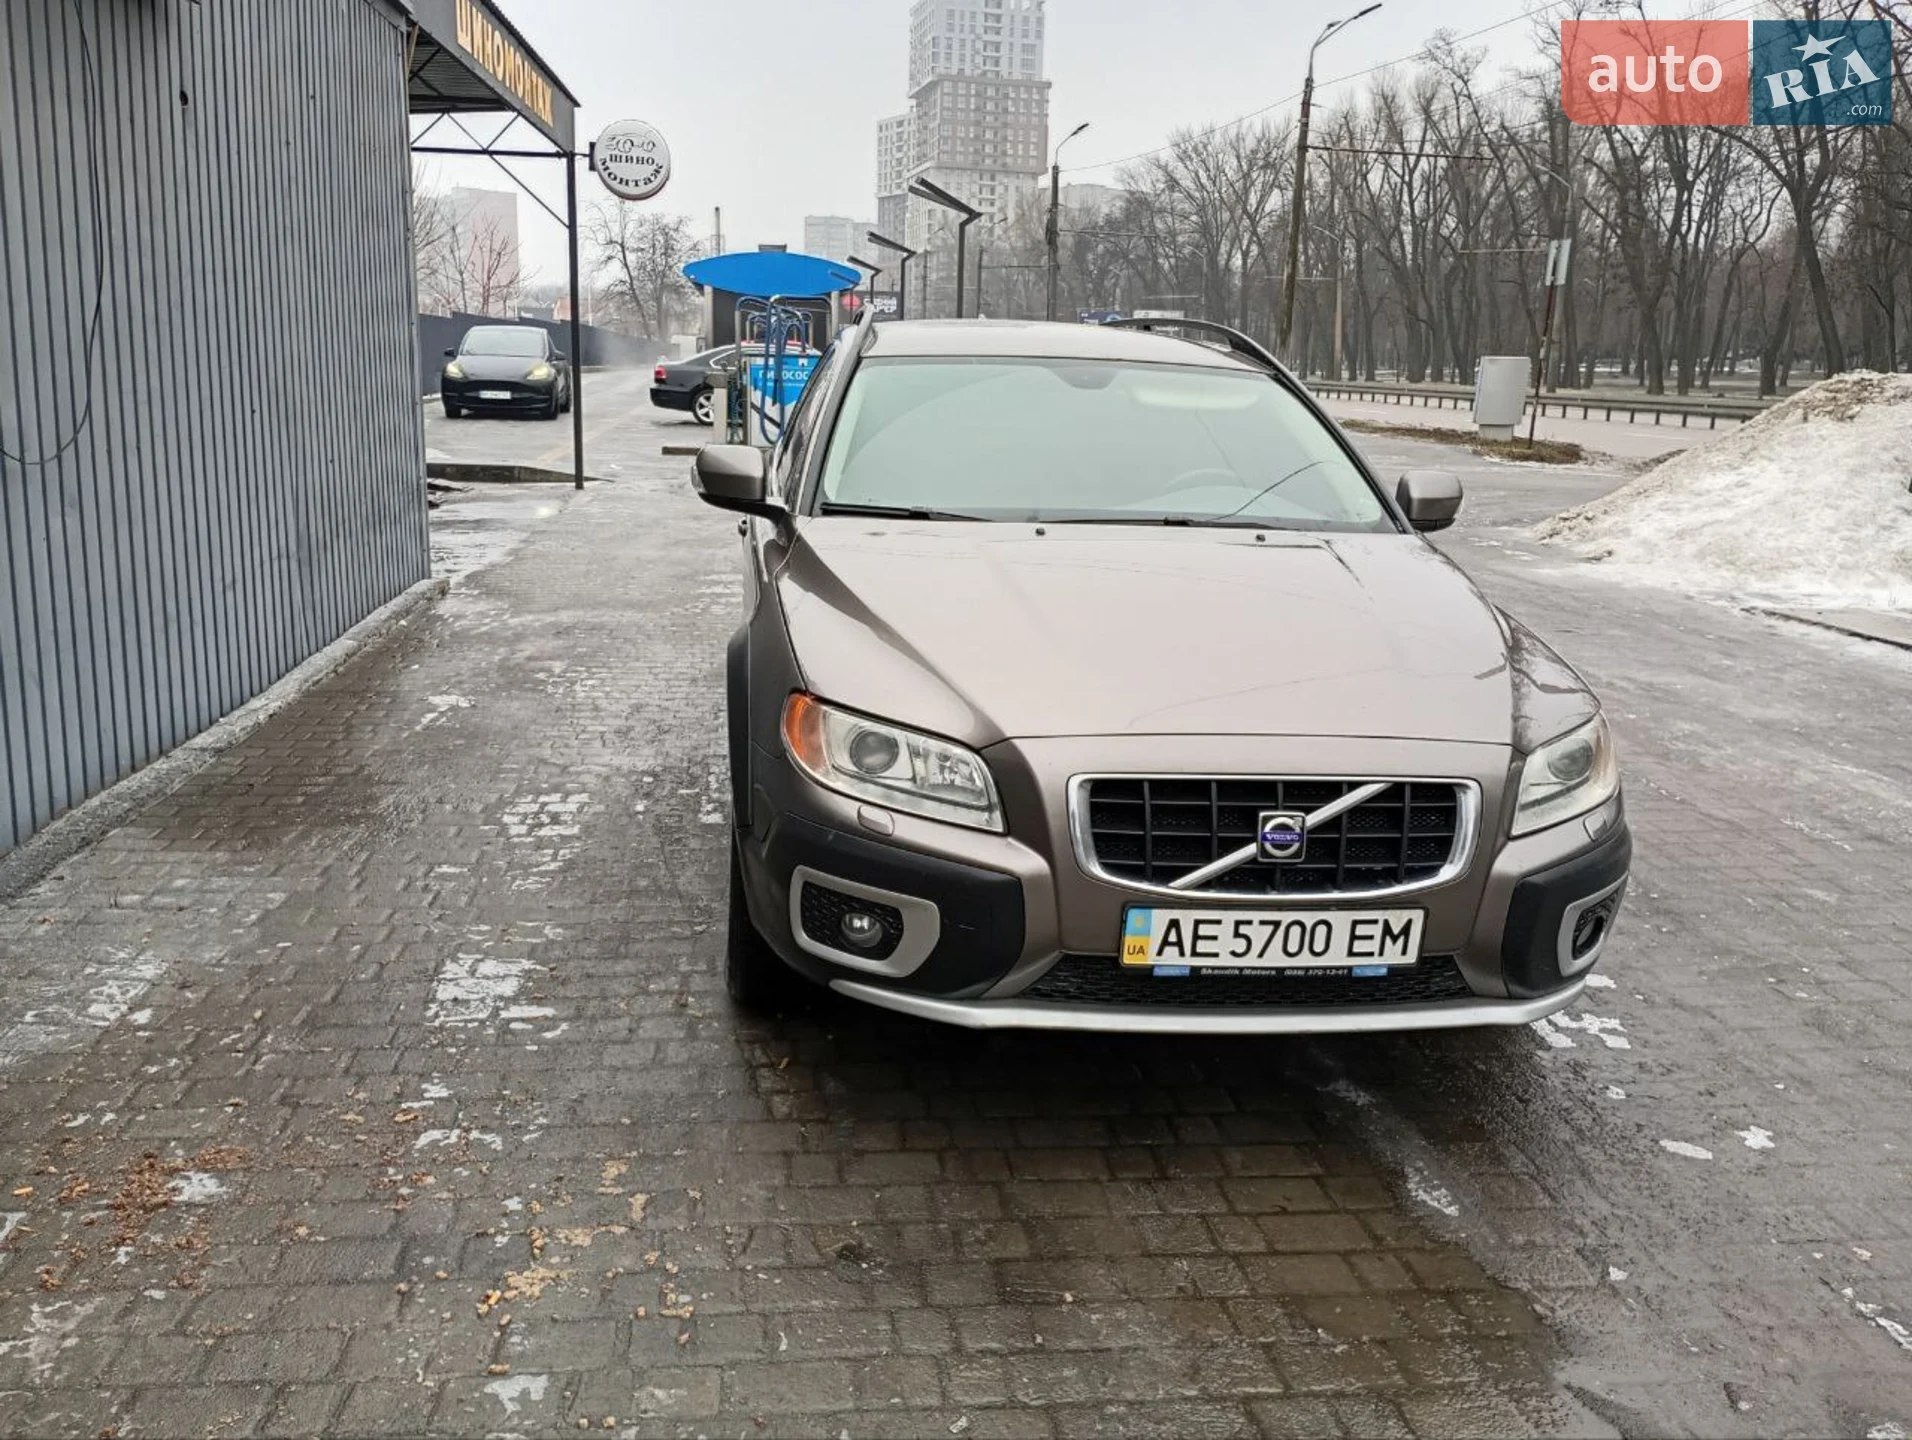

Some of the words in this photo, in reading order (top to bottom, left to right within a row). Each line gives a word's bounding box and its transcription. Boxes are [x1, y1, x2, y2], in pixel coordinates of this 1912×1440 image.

[1266, 833, 1299, 841] VOLVO
[1346, 918, 1412, 958] EM
[1127, 944, 1145, 956] UA
